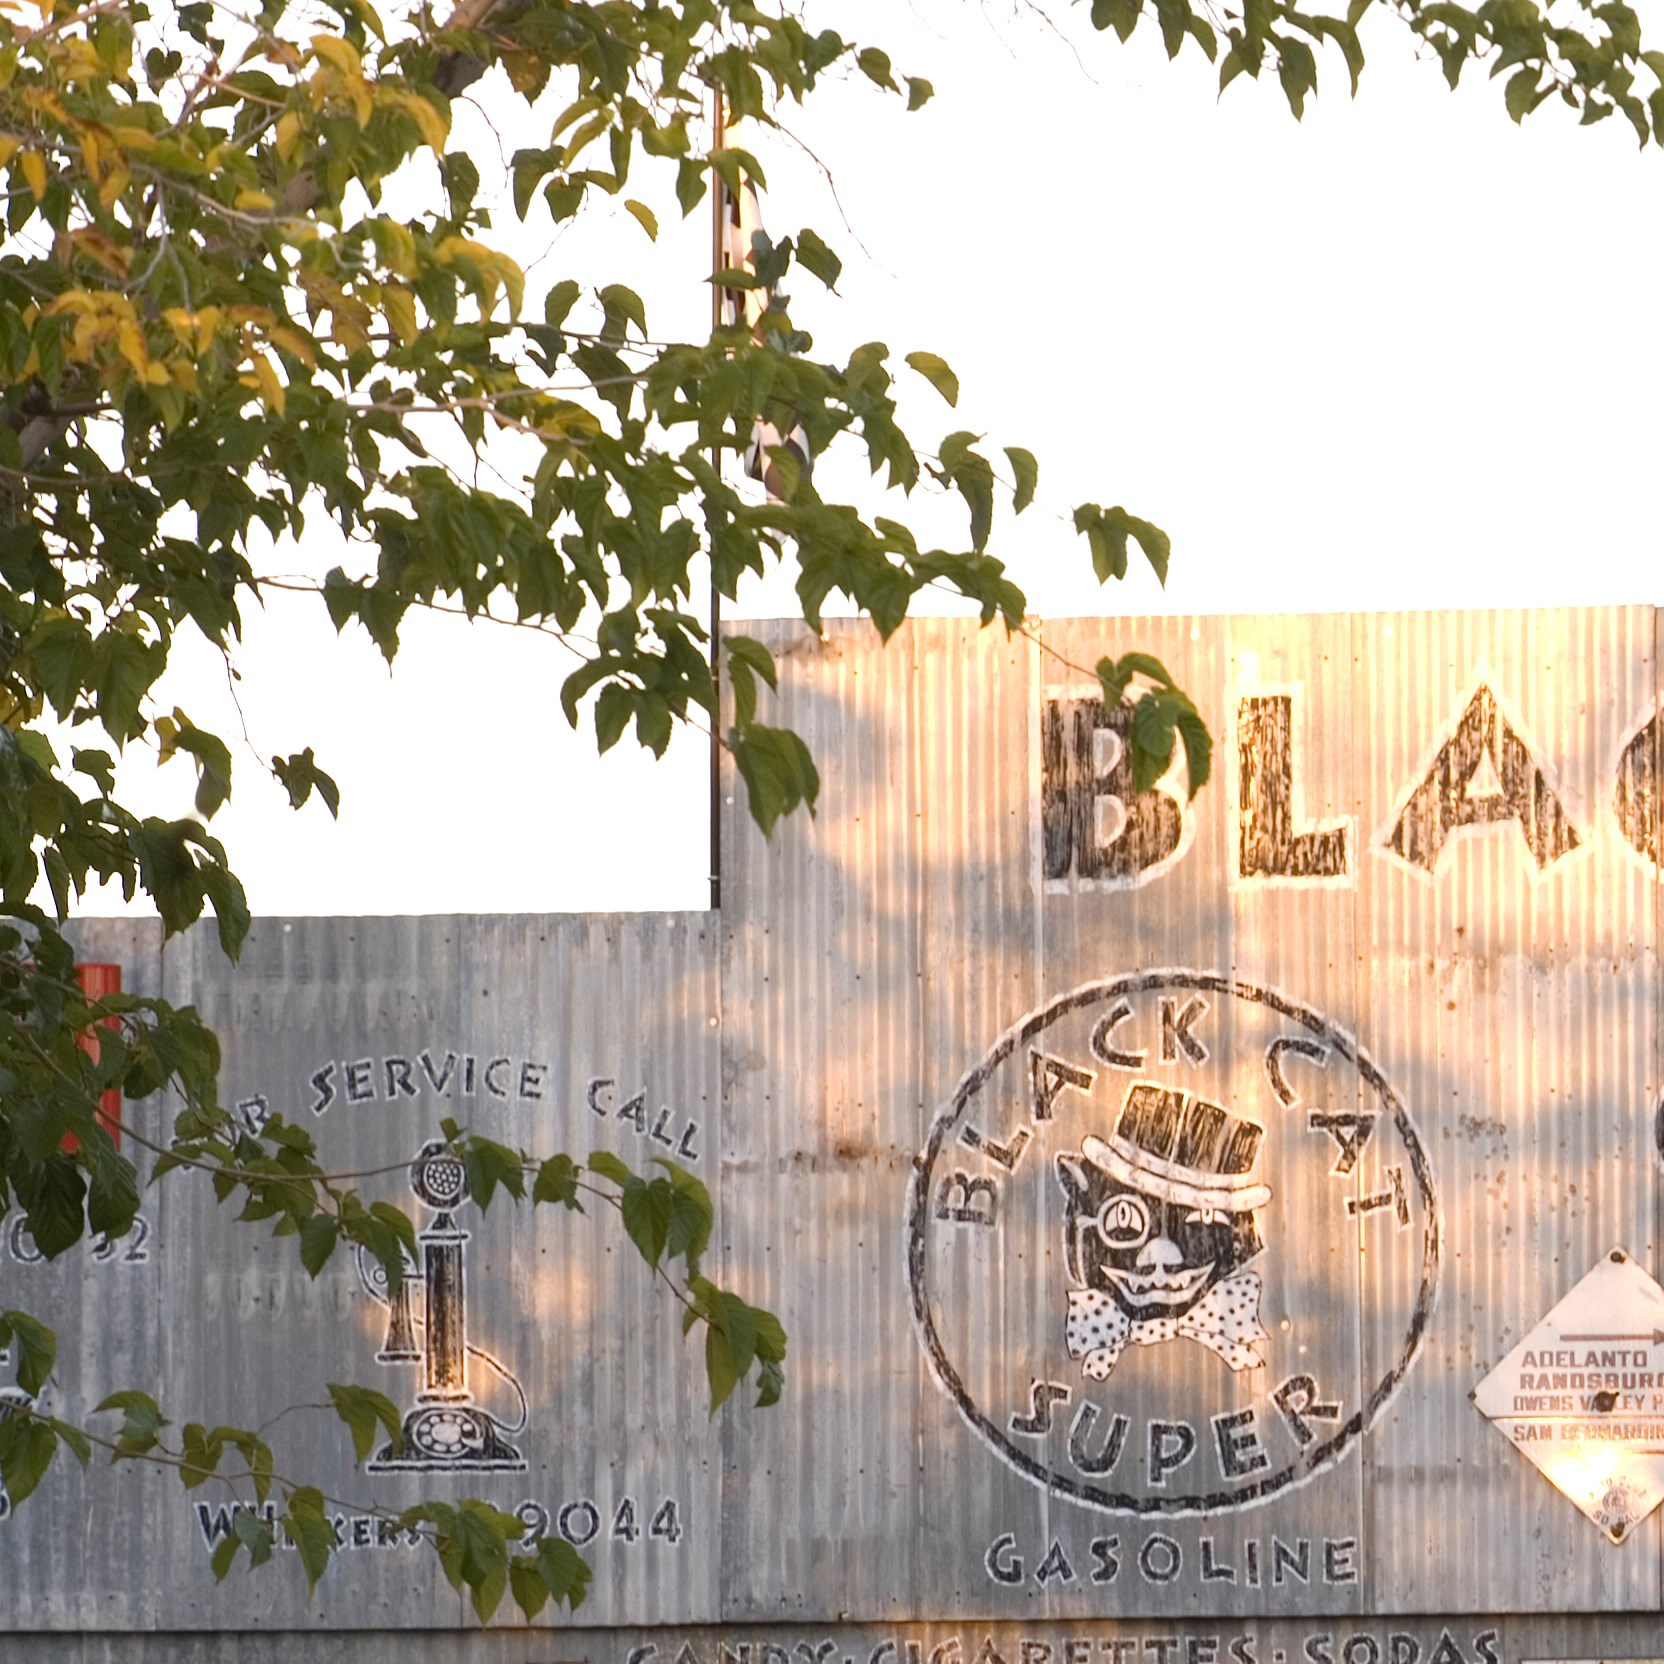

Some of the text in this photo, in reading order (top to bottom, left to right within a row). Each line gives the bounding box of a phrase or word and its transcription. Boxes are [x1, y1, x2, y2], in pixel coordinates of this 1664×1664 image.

[311, 1050, 701, 1162] SERVICE CALL
[932, 995, 1415, 1232] BLACK CAT
[1522, 1350, 1648, 1368] ADELANTO
[1010, 1373, 1342, 1486] SUPER
[1513, 1395, 1573, 1412] OWENS
[1513, 1424, 1552, 1441] SAN
[984, 1531, 1358, 1589] GASOLINE
